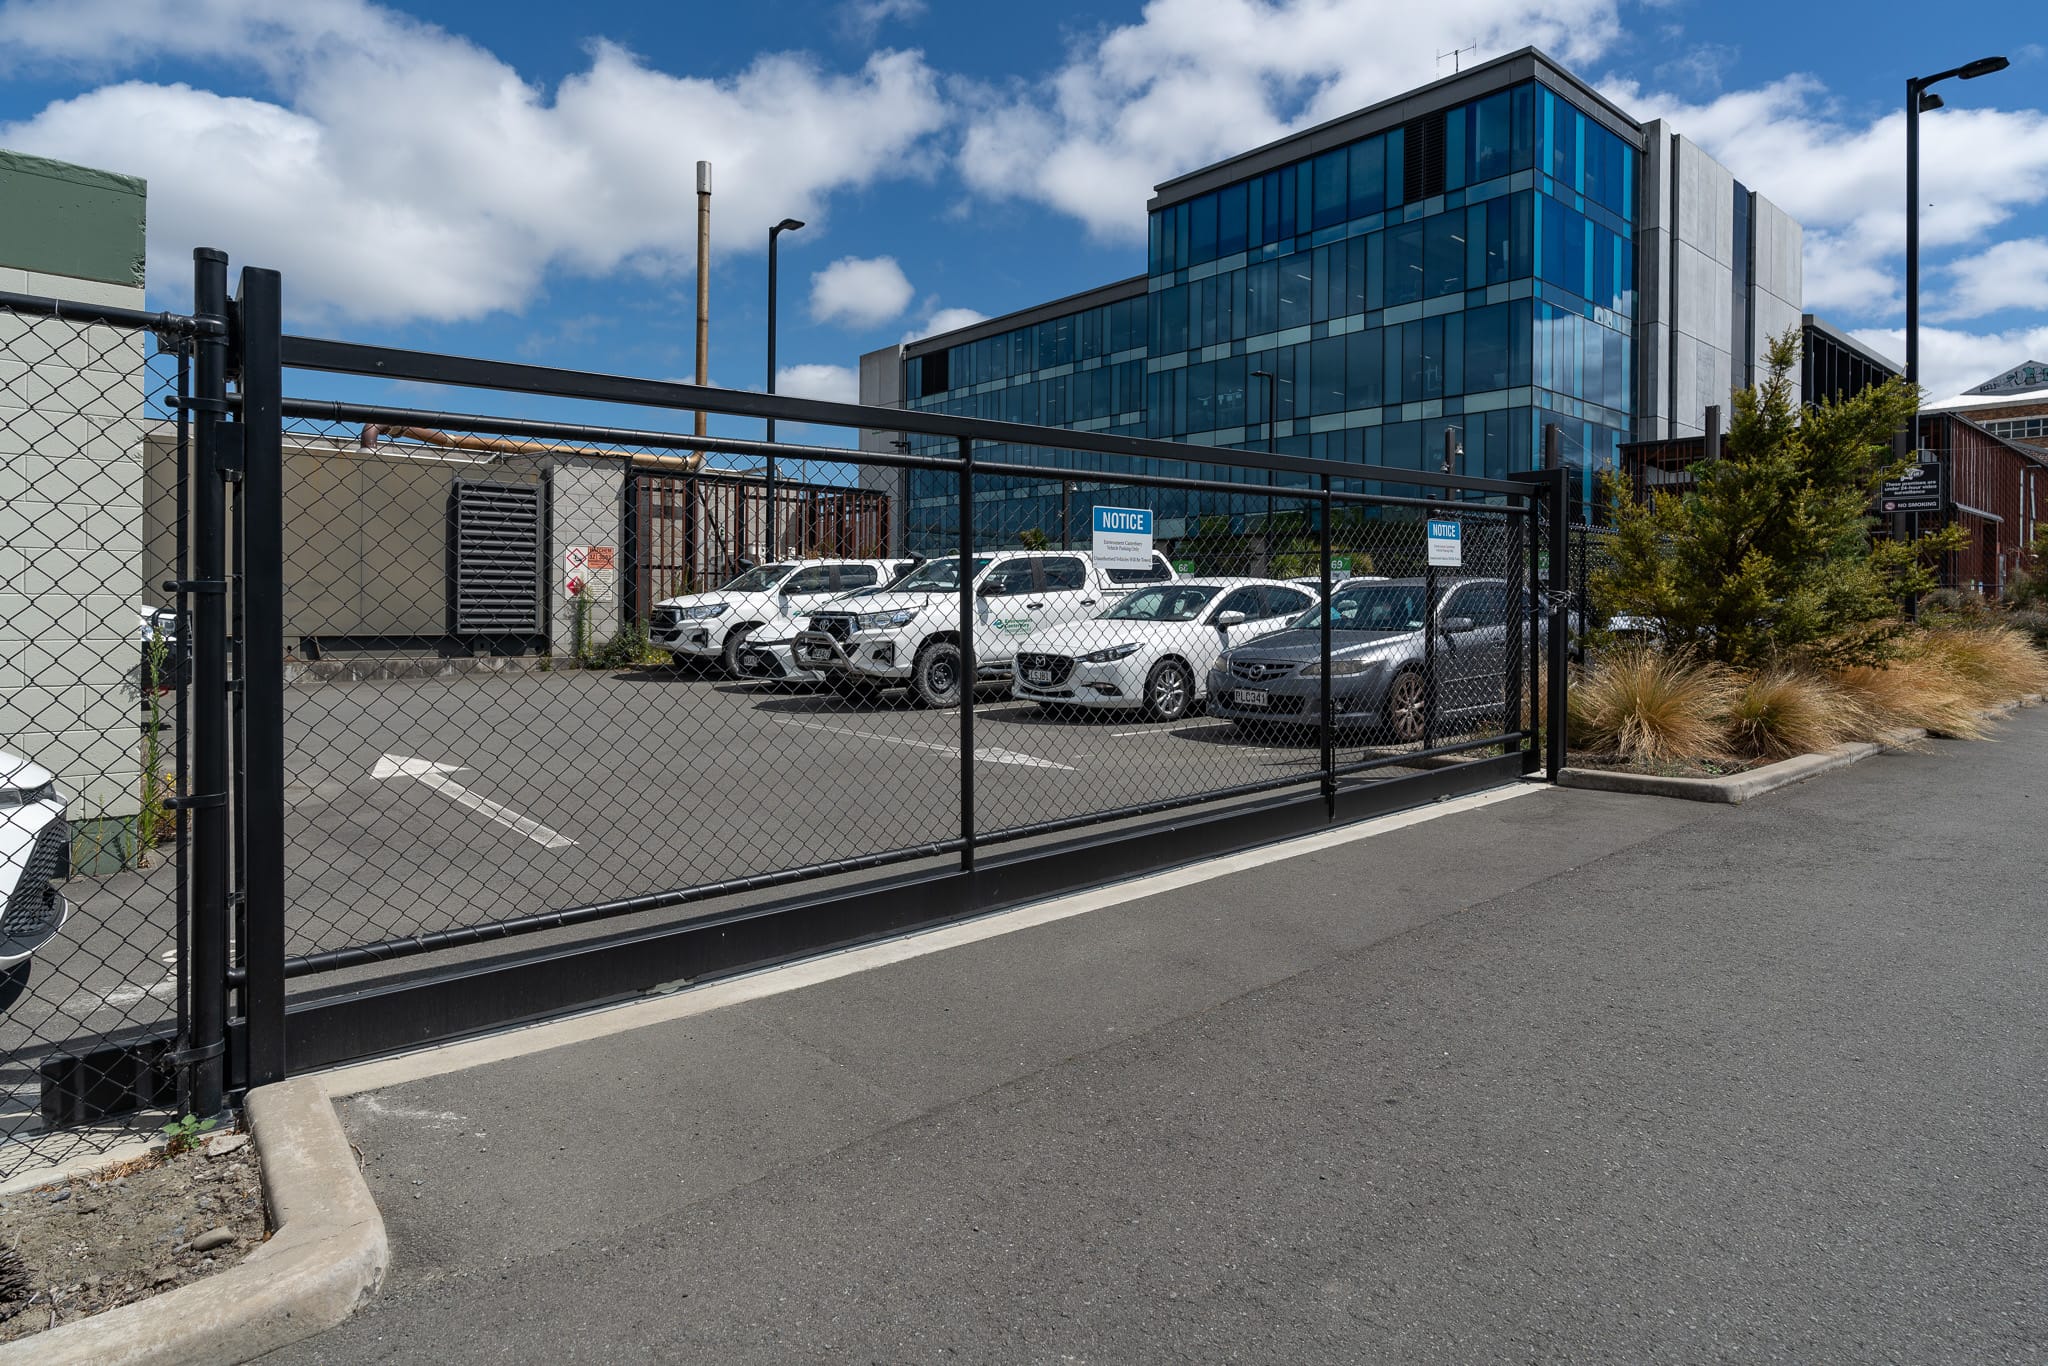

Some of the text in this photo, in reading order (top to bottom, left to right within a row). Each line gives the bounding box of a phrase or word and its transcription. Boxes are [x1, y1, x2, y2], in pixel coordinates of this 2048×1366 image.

[1102, 512, 1144, 530] NOTICE
[1432, 523, 1456, 537] NOTICE
[1331, 560, 1343, 569] 69
